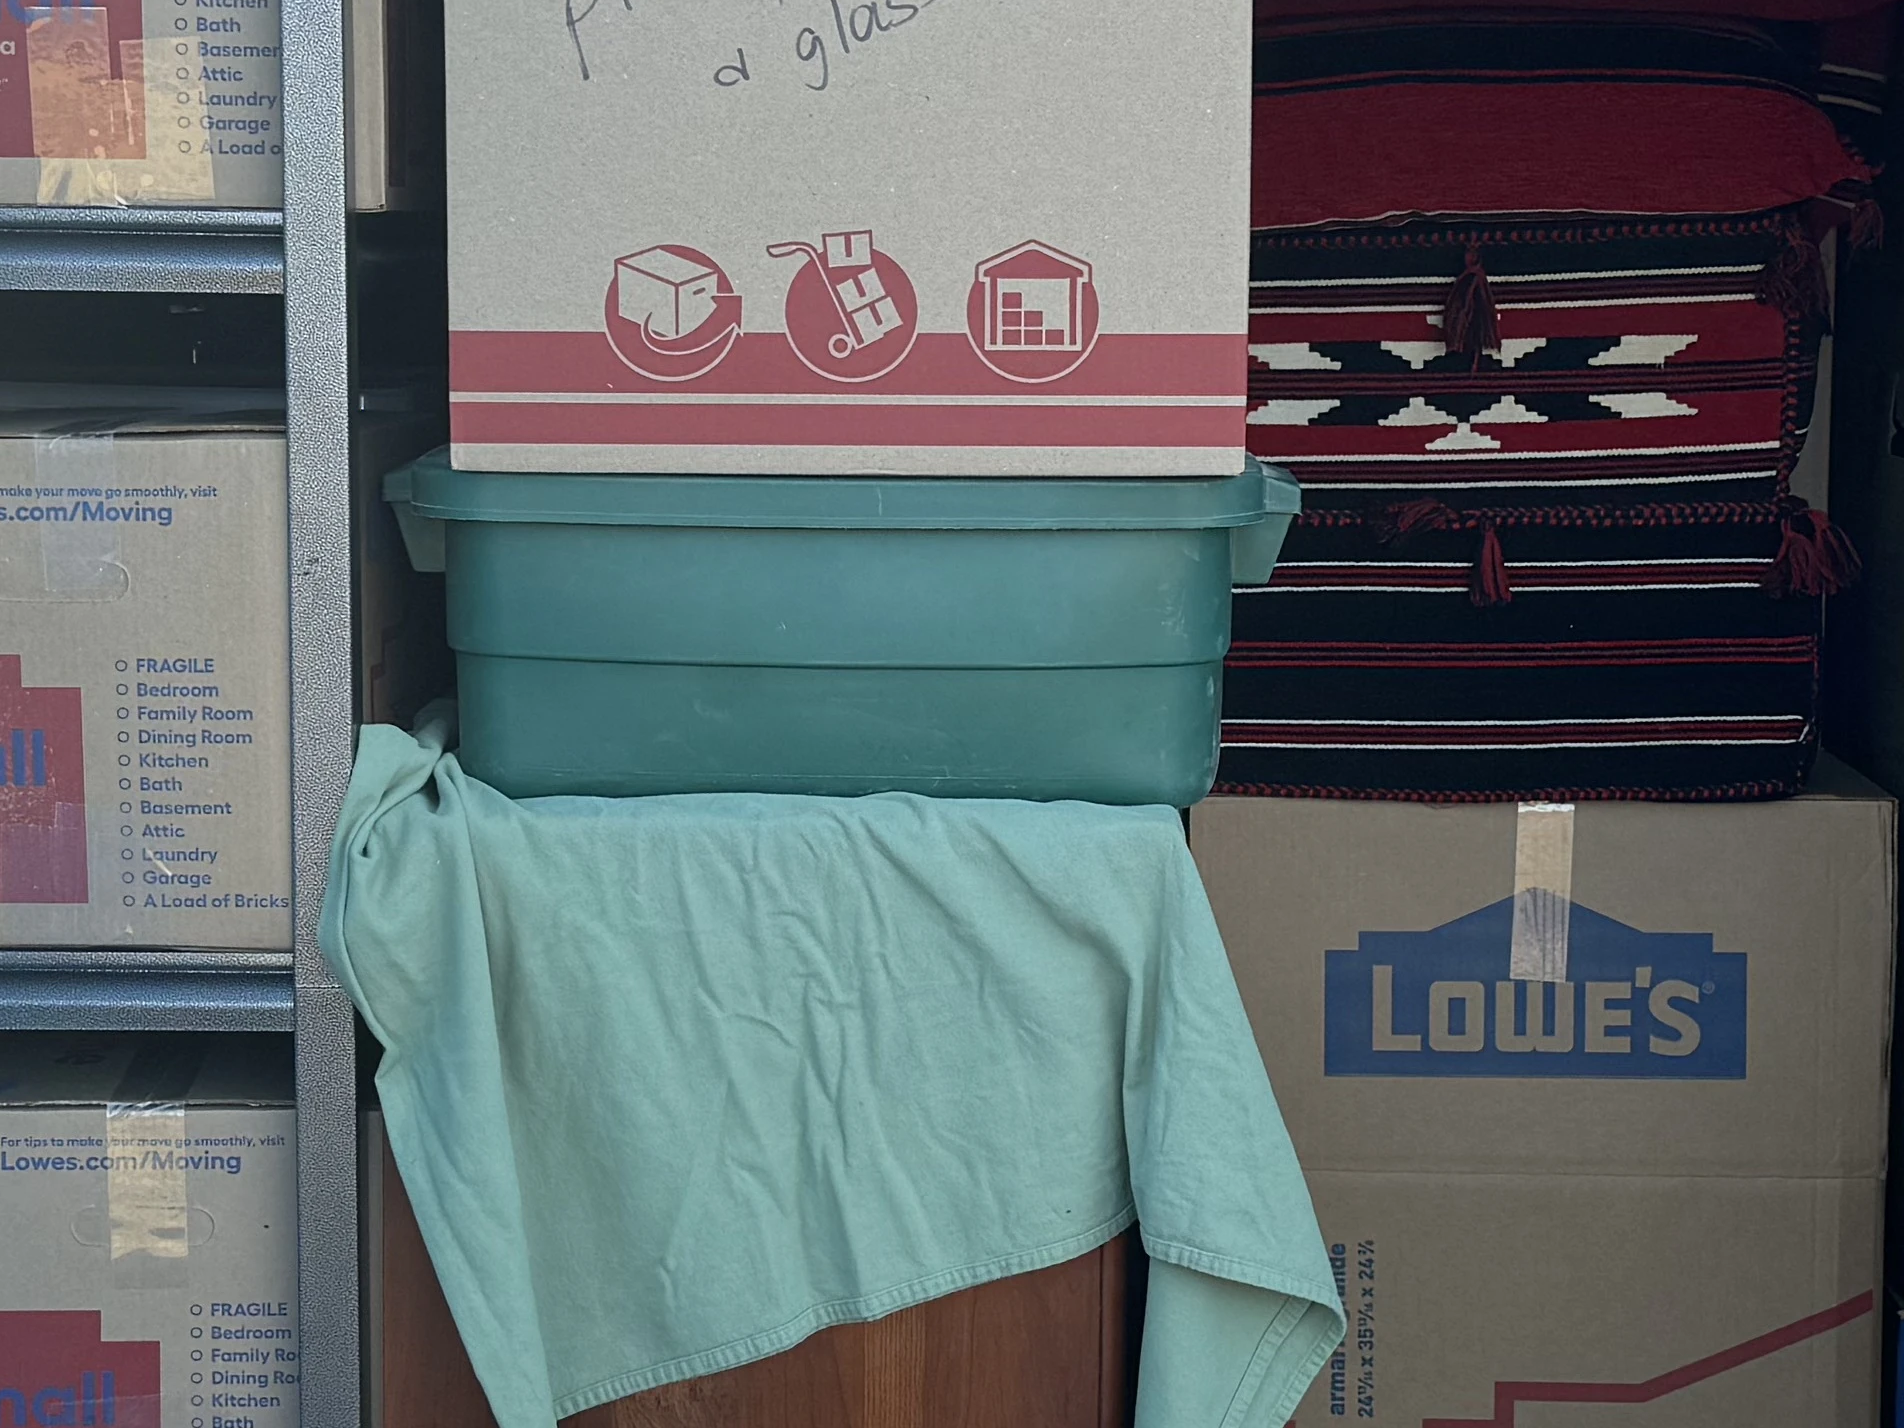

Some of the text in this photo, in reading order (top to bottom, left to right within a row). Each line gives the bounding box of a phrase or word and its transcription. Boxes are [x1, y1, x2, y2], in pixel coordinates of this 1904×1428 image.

[35, 488, 65, 499] your
[67, 488, 102, 499] move
[105, 489, 122, 501] go
[124, 486, 188, 500] smoothly,
[191, 486, 218, 498] visit
[136, 658, 214, 675] FRAGILE
[136, 683, 220, 699] Bedroom
[137, 706, 254, 723] Family Room
[138, 730, 253, 748] Dining Room
[139, 754, 208, 769] Kitchen
[139, 777, 183, 793] Bath
[140, 800, 233, 816] Basement
[142, 824, 185, 839] Attic
[141, 847, 218, 866] Laundry
[142, 870, 211, 888] Garage
[144, 893, 289, 909] A Load of Bricks
[1370, 964, 1700, 1058] LOWE'S
[0, 1149, 243, 1176] Lowes.com/Moving
